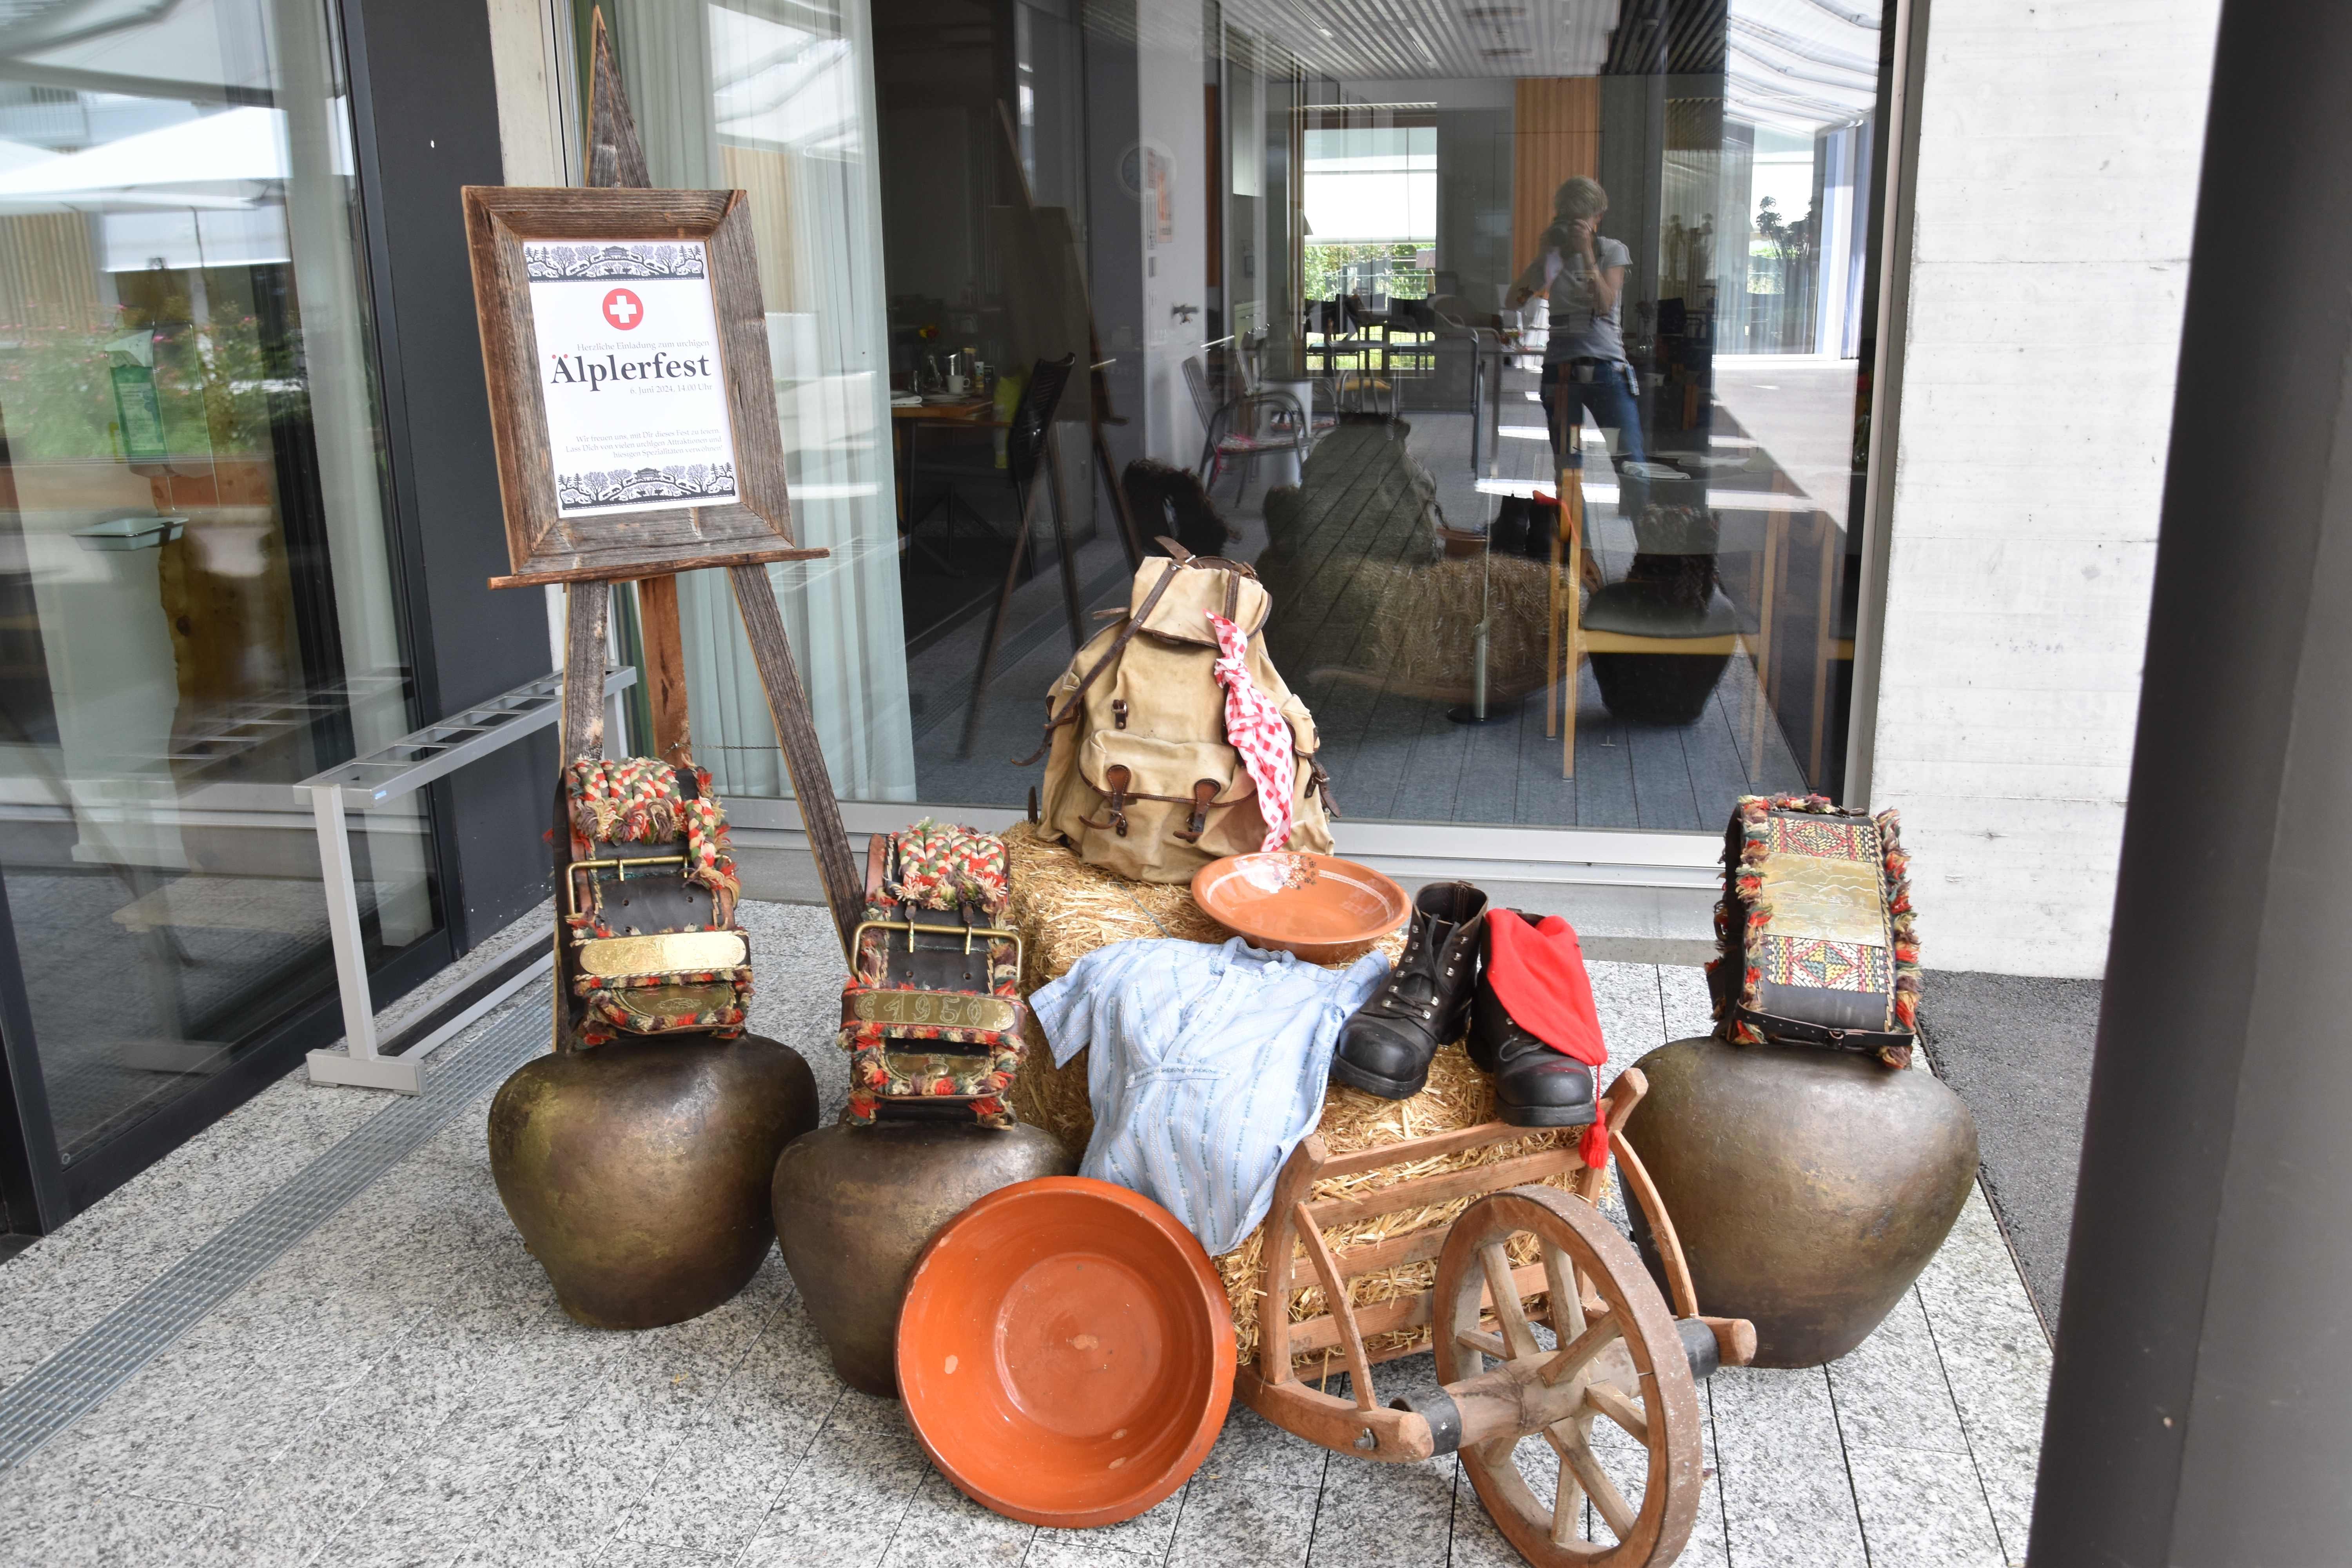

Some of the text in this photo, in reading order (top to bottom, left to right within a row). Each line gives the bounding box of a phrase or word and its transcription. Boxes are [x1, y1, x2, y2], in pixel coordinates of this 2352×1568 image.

[577, 343, 615, 351] Herzliche
[617, 341, 656, 350] Einladung
[677, 339, 710, 348] urchigen
[550, 352, 711, 392] Älplerfest
[639, 386, 654, 395] Juni
[583, 443, 599, 452] Dich
[636, 440, 665, 448] urchigen
[667, 437, 708, 446] Attraktionen
[613, 445, 723, 459] hiesigen Spezialitäten verwöhnen!
[883, 993, 982, 1026] 1950
